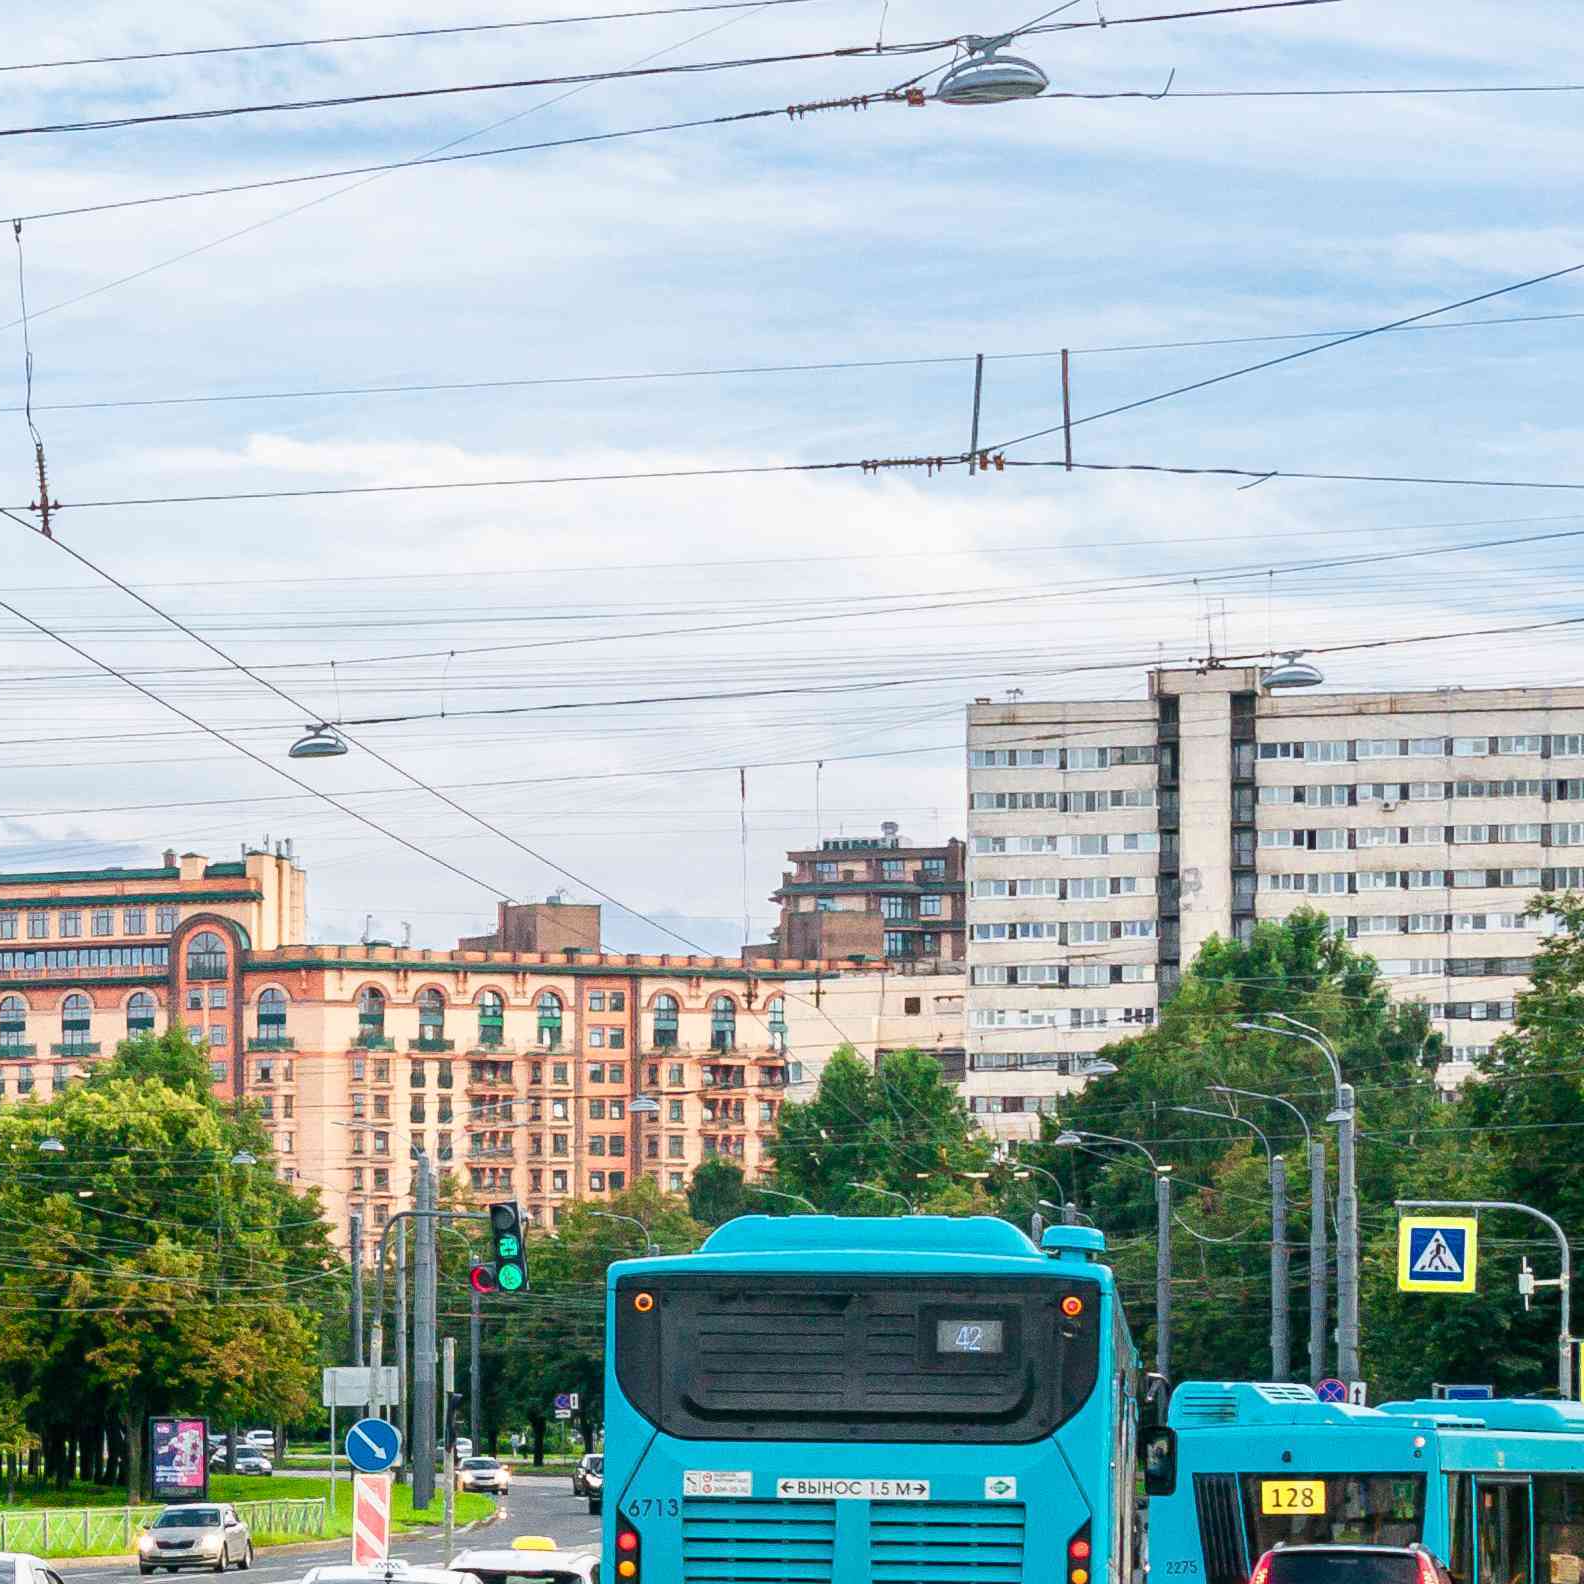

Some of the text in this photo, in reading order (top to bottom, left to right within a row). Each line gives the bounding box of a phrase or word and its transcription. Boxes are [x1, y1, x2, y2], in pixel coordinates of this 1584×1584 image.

[797, 1481, 911, 1496] ВЫНОС 1.5 М
[1272, 1488, 1314, 1507] 128
[628, 1499, 680, 1517] 6713
[1166, 1561, 1199, 1575] 2275
